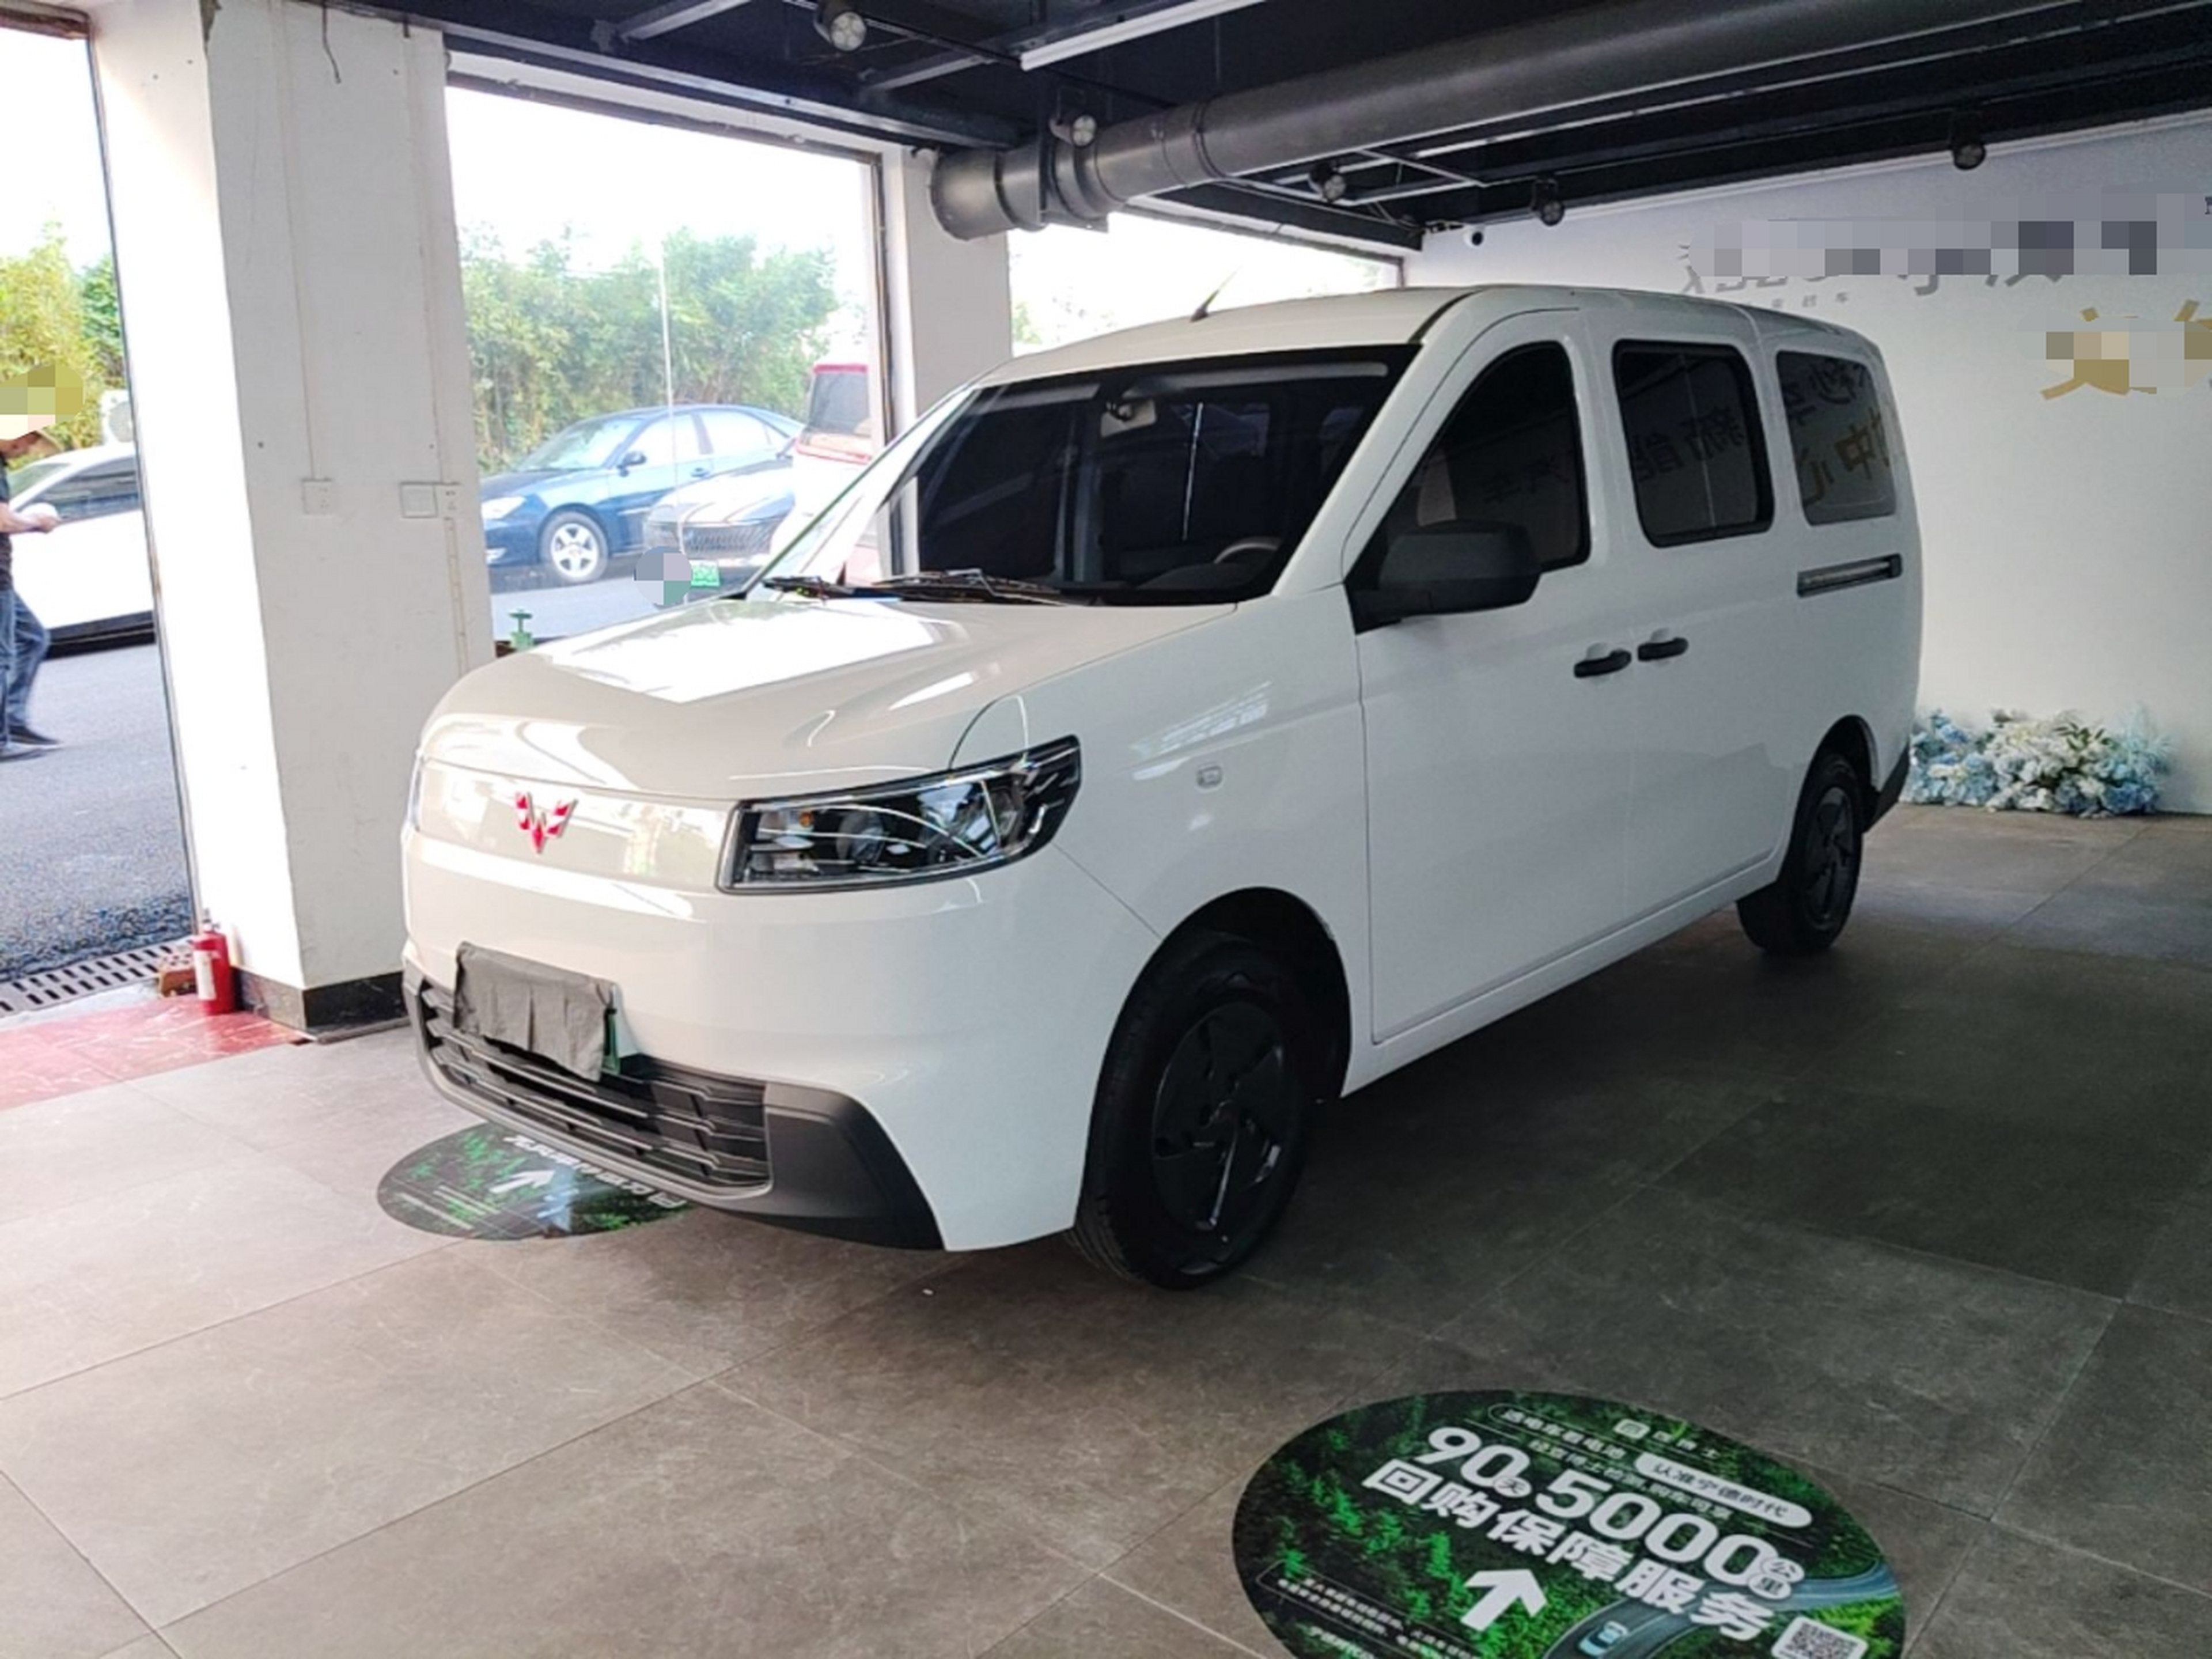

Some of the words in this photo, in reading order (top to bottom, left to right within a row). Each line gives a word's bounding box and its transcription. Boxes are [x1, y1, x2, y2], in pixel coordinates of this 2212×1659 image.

[1361, 1458, 1775, 1641] 回购保障服务
[1653, 1463, 1789, 1518] 认准宁德时代
